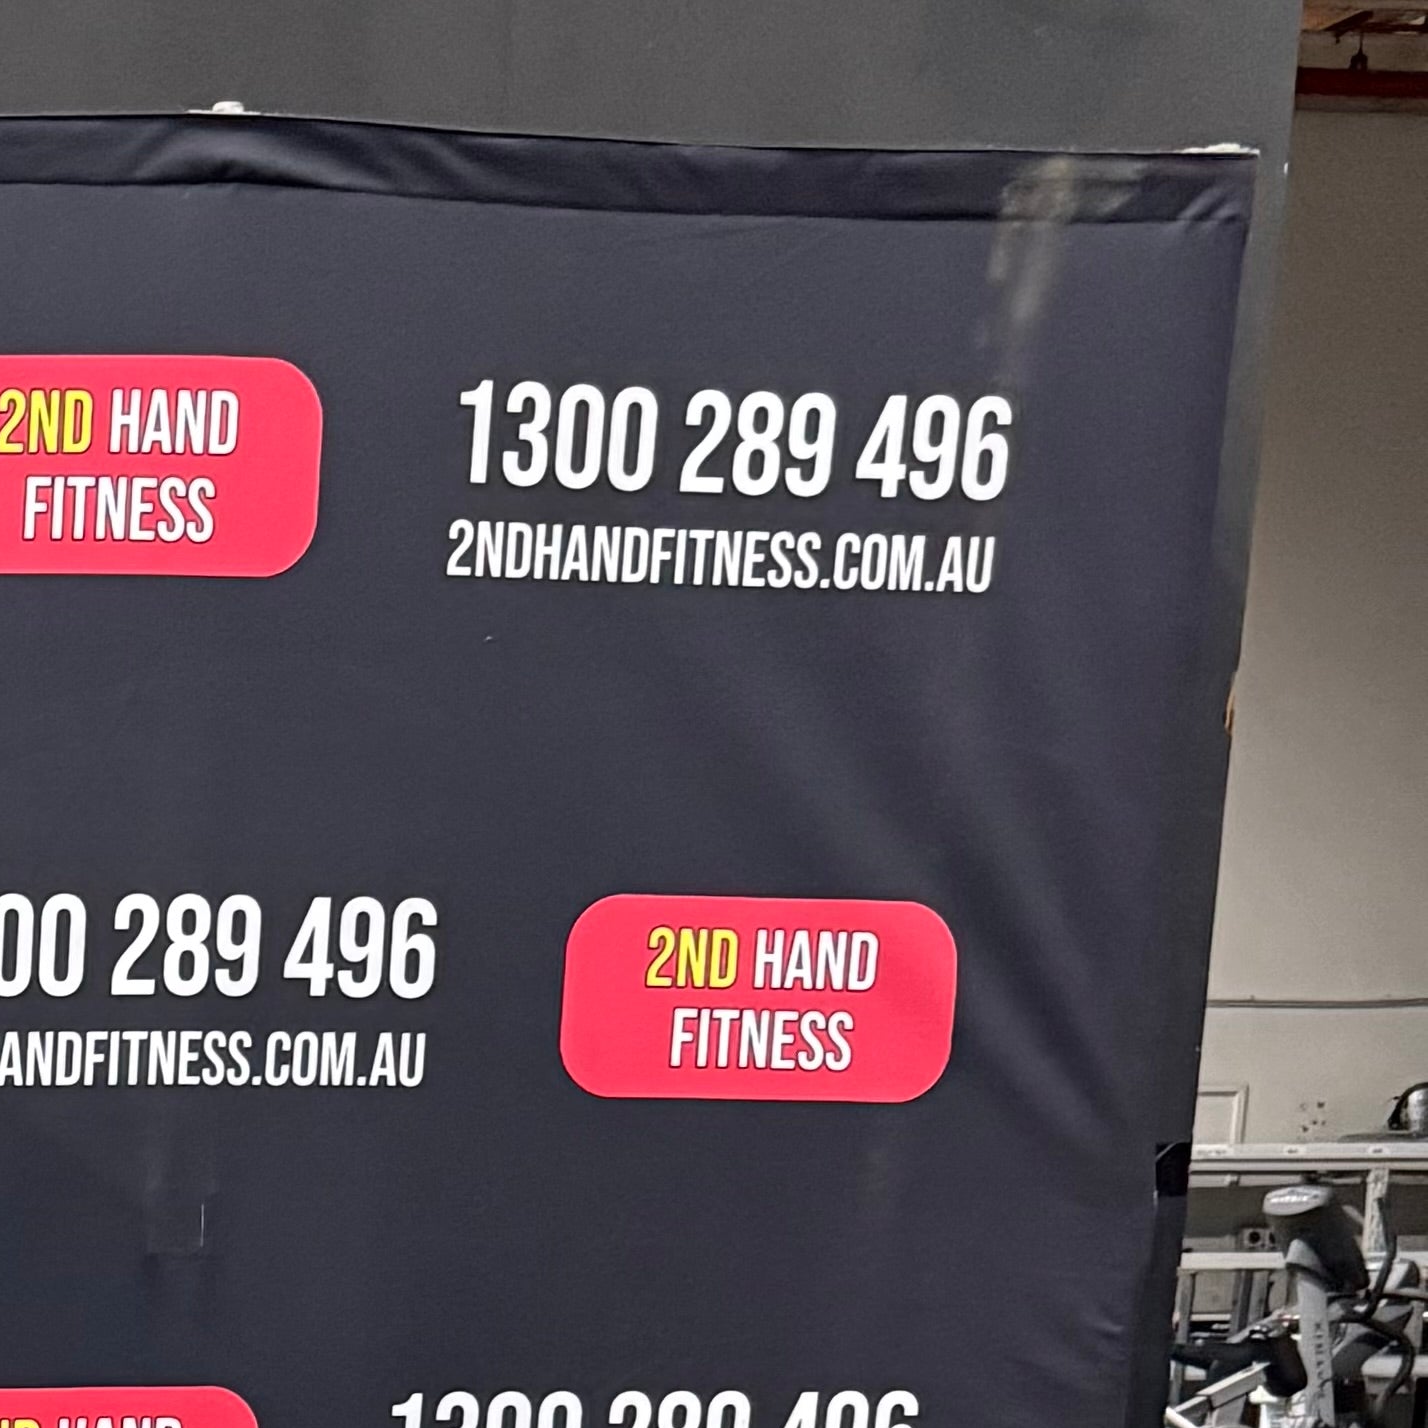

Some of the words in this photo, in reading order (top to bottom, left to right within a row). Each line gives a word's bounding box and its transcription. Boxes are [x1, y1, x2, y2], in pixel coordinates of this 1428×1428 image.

[111, 390, 238, 454] HAND
[461, 380, 658, 491] 1300
[680, 390, 836, 496] 289
[856, 395, 1012, 500] 496
[24, 477, 214, 542] FITNESS
[447, 519, 995, 592] 2NDHANDFITNESS.COM.AU
[111, 894, 261, 996] 289
[284, 897, 437, 998] 496
[647, 928, 737, 987] 2ND
[755, 930, 878, 990] HAND
[671, 1009, 853, 1070] FITNESS
